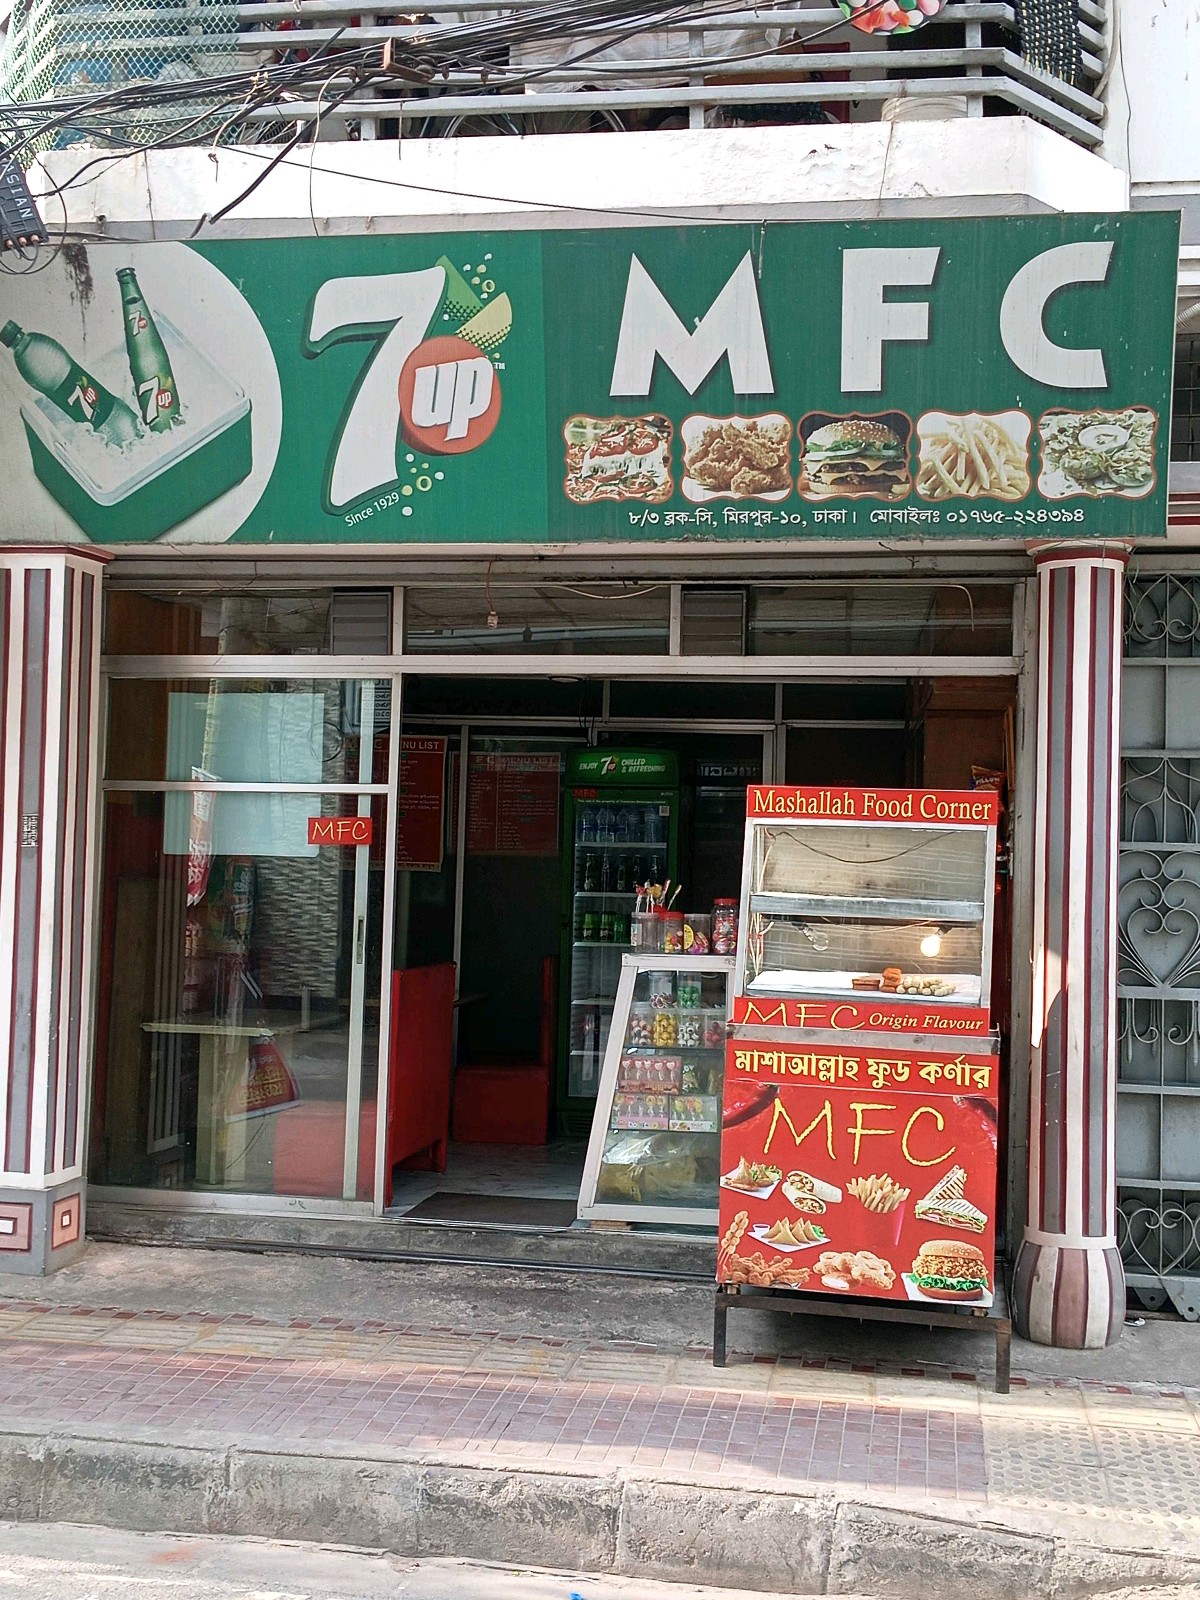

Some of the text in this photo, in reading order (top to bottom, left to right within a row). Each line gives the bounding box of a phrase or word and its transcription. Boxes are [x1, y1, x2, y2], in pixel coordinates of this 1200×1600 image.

[344, 492, 400, 527] Since 1929
[628, 509, 659, 527] ৮/৩
[722, 507, 807, 527] মিরপুর-১০,
[946, 508, 1085, 525] ০১৭৬৫-২২৪৩৯৪
[418, 741, 440, 750] LIST
[579, 762, 598, 770] ENJOY
[621, 758, 646, 766] CHILLED
[629, 765, 665, 773] REFRESHING
[753, 789, 991, 820] Mashallah Food Corner
[313, 821, 368, 840] MFC
[743, 1001, 984, 1031] MFC Origin Flavour
[734, 1050, 859, 1083] মাশাআল্লাহ
[866, 1057, 911, 1089] ফুড
[919, 1055, 992, 1088] কর্ণার
[763, 1097, 957, 1167] MFC
